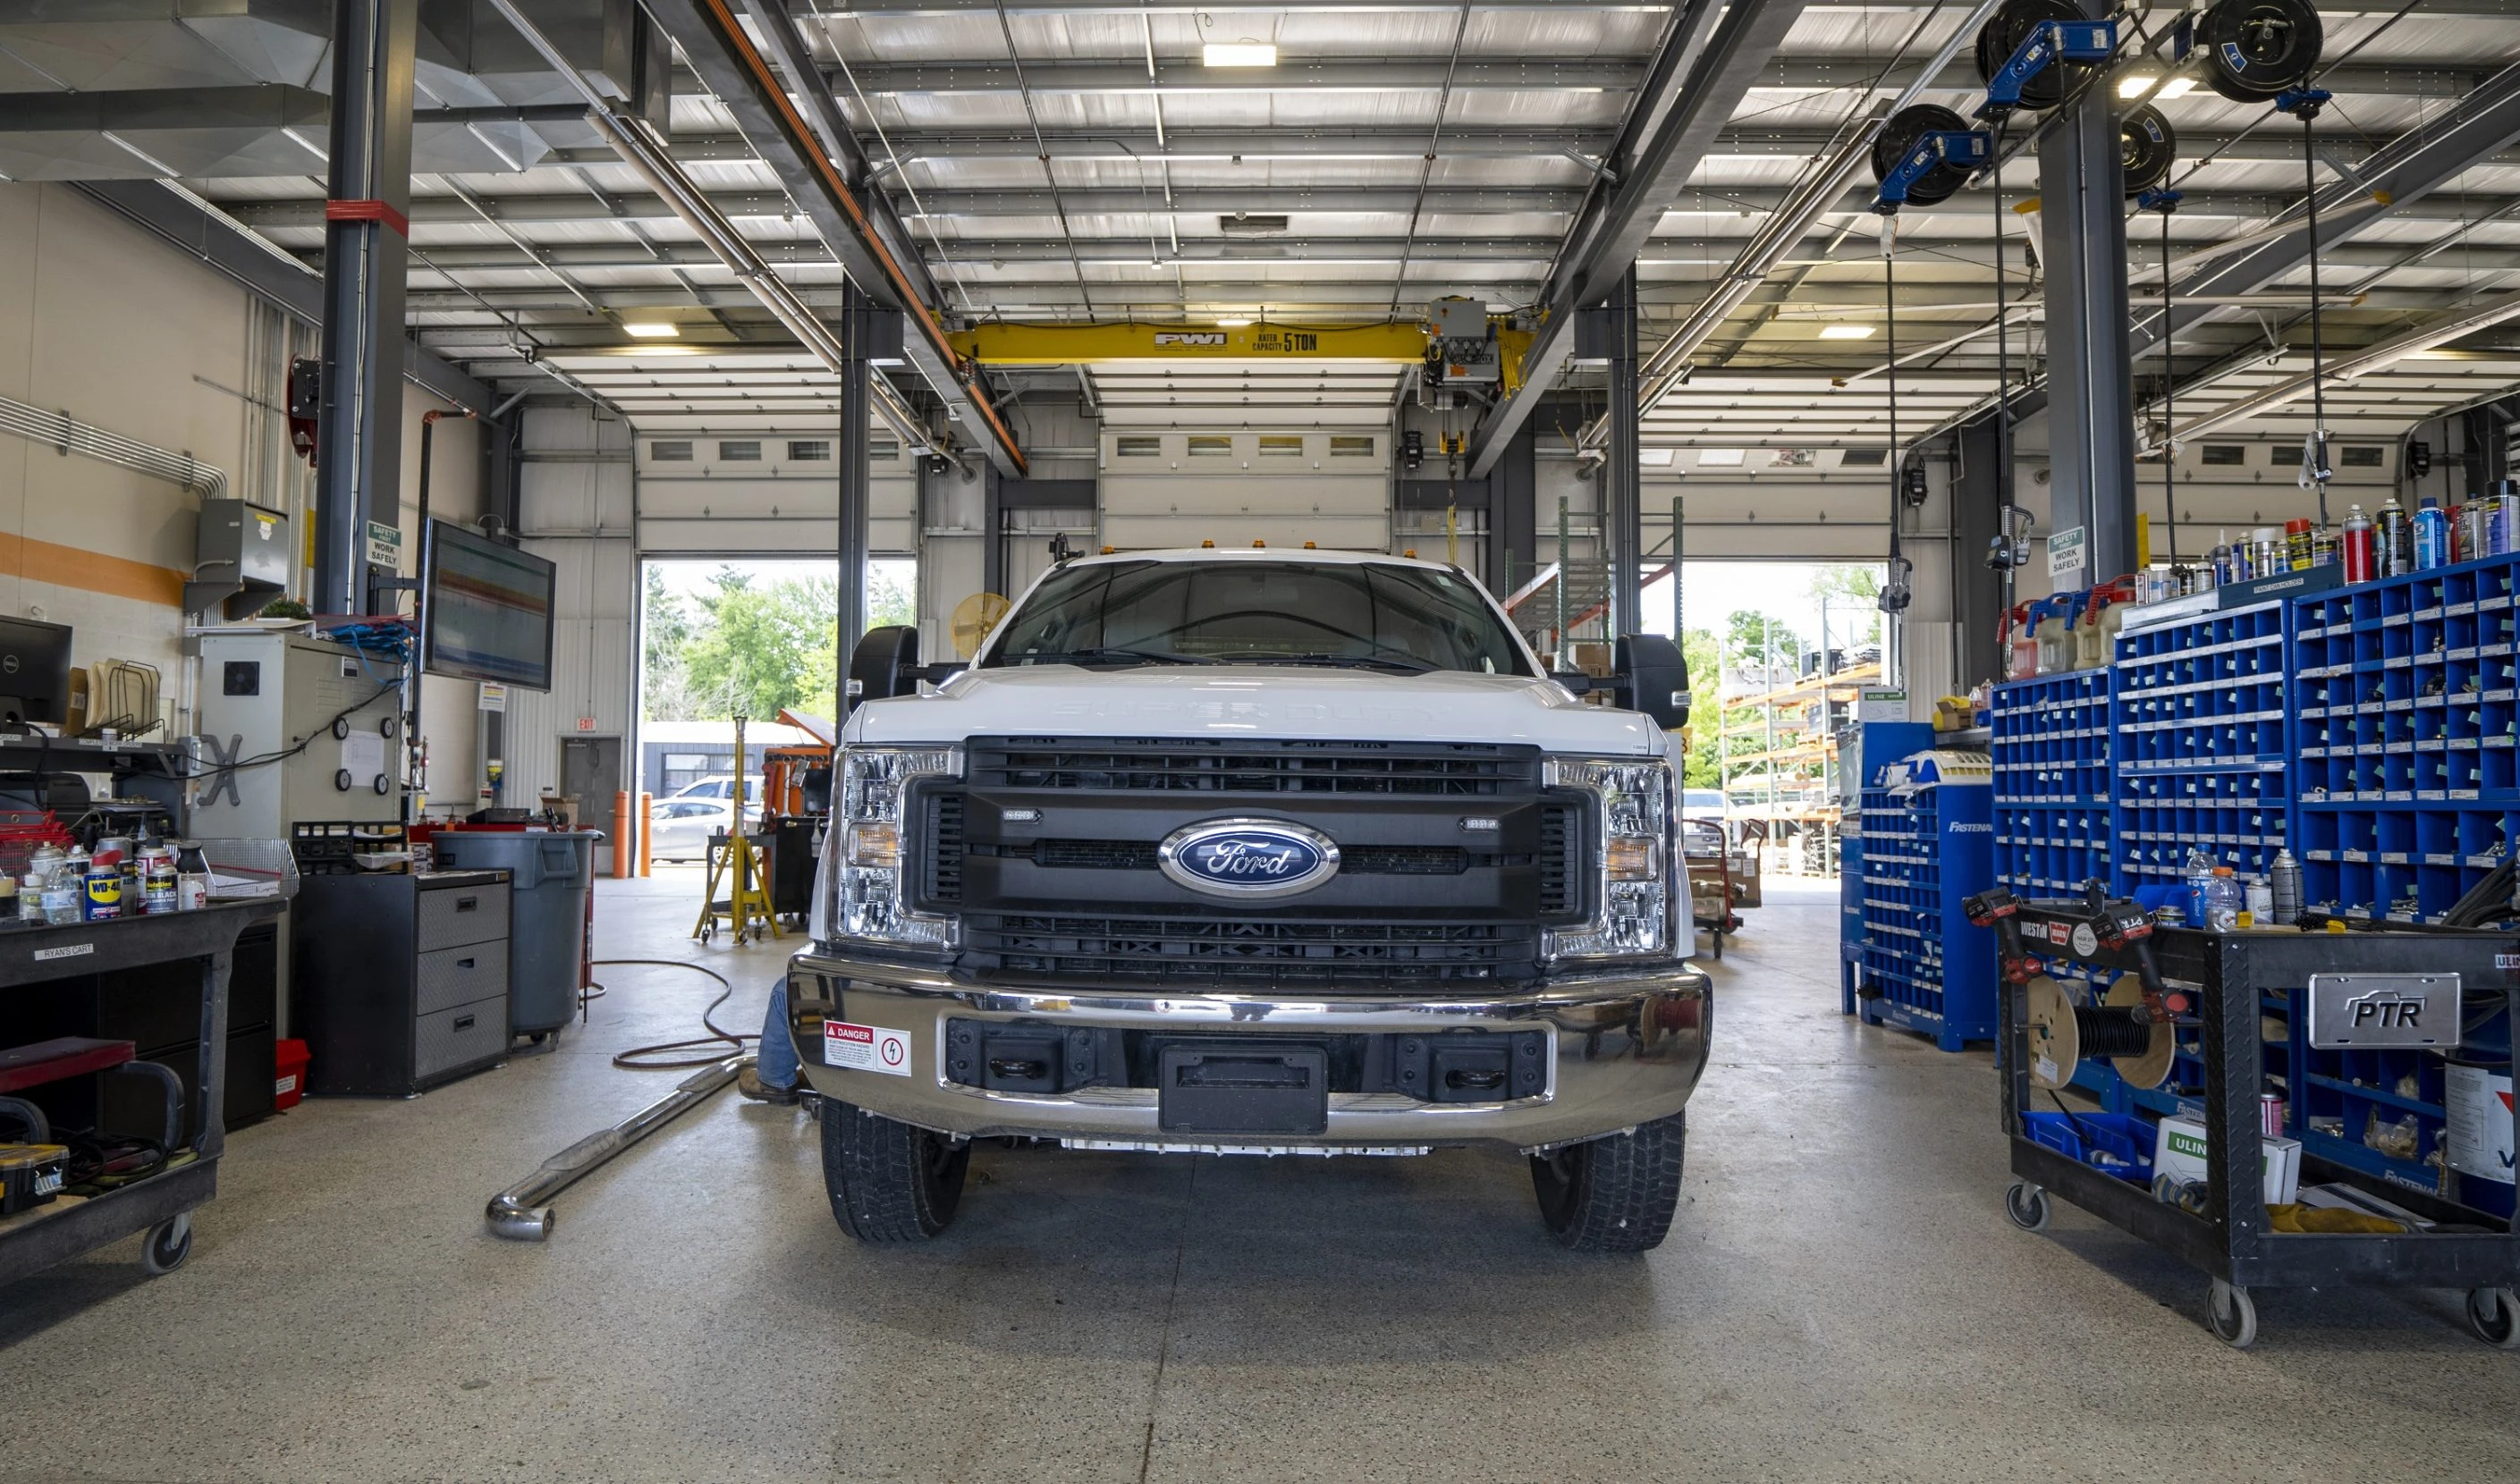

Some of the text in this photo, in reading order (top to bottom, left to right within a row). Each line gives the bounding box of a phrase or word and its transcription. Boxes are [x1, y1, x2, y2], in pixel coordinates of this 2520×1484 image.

[1154, 332, 1228, 345] PWI
[1258, 333, 1277, 341] RATED
[1284, 333, 1316, 352] 5 TON
[1252, 343, 1281, 351] CAPACITY
[373, 525, 396, 538] SAFETY
[2053, 531, 2077, 545] SAFETY
[374, 542, 394, 554] WORK
[2055, 548, 2076, 561] WORK
[371, 552, 397, 564] SAFELY
[2053, 557, 2080, 572] SAFELY
[579, 719, 594, 729] EXIT
[1207, 839, 1291, 874] Ford
[157, 891, 177, 899] BLACK
[2194, 898, 2202, 917] pepsi
[45, 944, 91, 958] RYAN'S CART
[2352, 1000, 2423, 1028] PTR
[837, 1028, 870, 1041] DANGER
[2177, 1101, 2205, 1117] FASTEN
[2176, 1137, 2206, 1156] ULIN
